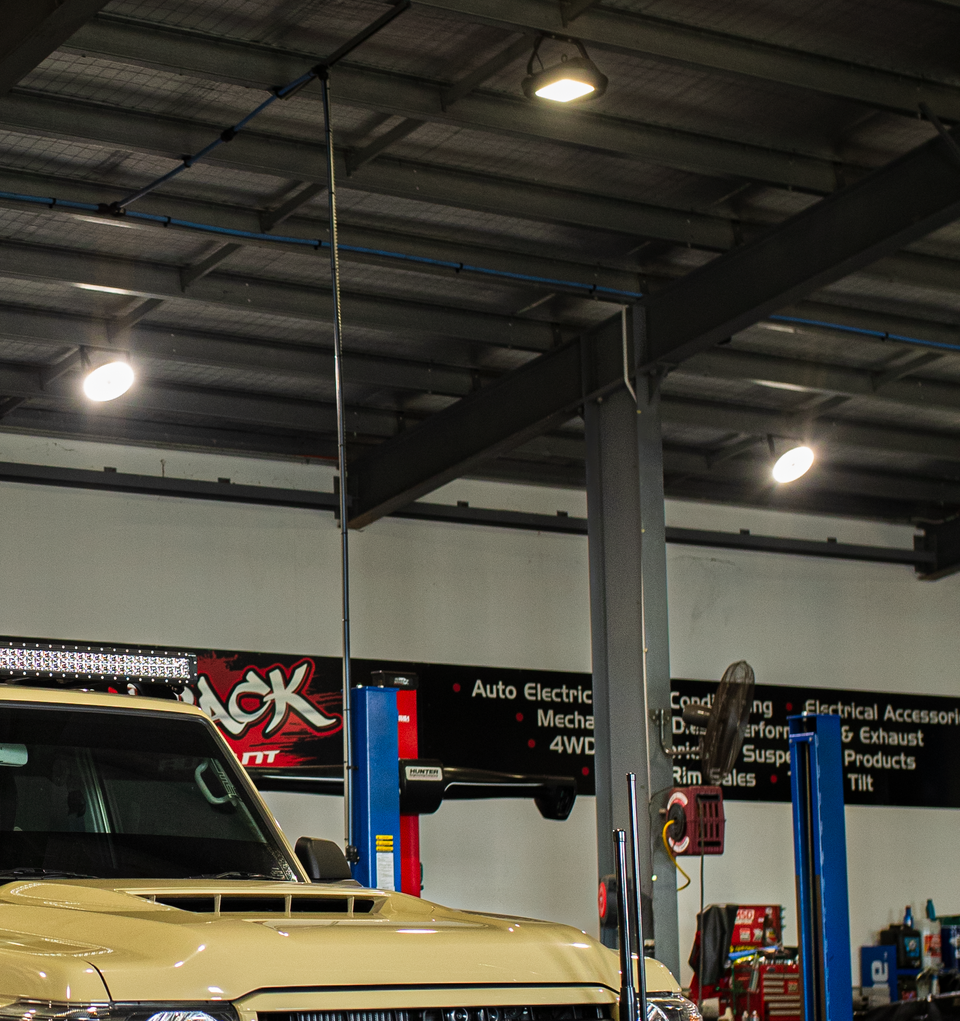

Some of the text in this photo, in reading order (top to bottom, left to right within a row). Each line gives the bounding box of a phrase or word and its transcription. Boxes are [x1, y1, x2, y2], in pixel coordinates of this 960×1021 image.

[471, 679, 517, 700] Auto
[524, 682, 593, 704] Electric
[537, 708, 594, 729] Mecha
[884, 704, 960, 725] Accessori
[549, 735, 595, 755] 4WD
[841, 725, 854, 743] &
[859, 726, 924, 747] Exhaust
[844, 749, 917, 770] Products
[673, 766, 757, 787] Rim Sales
[847, 773, 874, 792] Tilt
